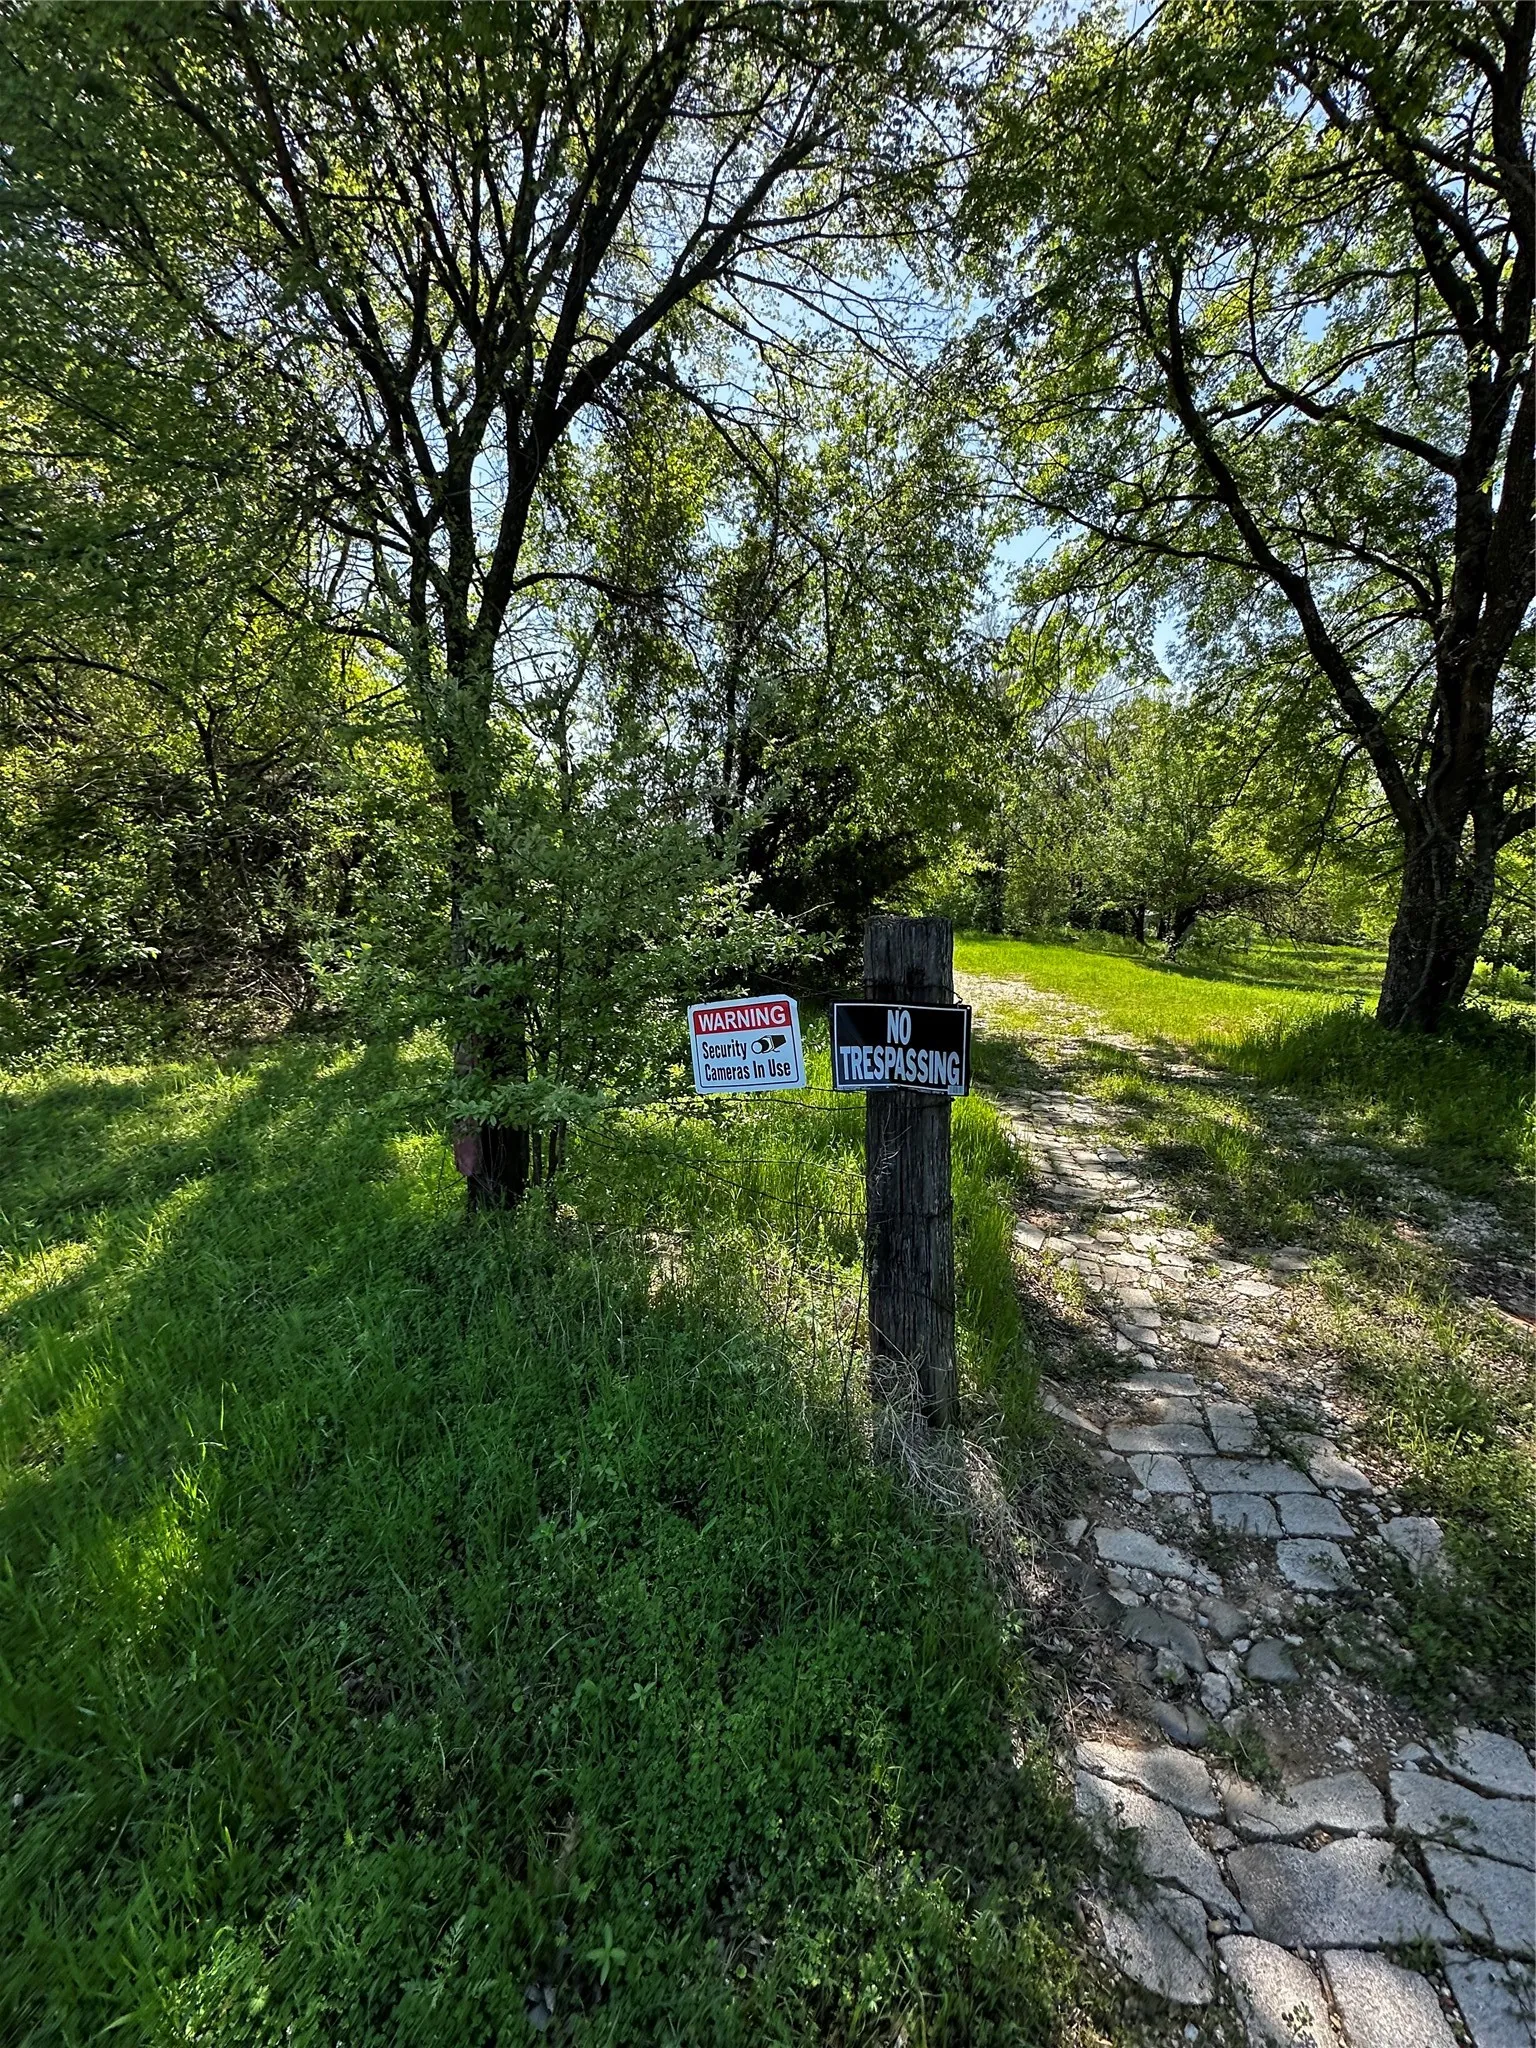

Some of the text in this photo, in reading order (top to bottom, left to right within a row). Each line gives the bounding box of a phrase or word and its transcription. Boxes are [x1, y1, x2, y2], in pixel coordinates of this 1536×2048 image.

[698, 1005, 786, 1032] WARNING
[887, 1009, 912, 1045] NO
[702, 1039, 747, 1060] Security
[704, 1058, 791, 1081] Cameras In Use
[839, 1045, 960, 1086] TRESPASSING
